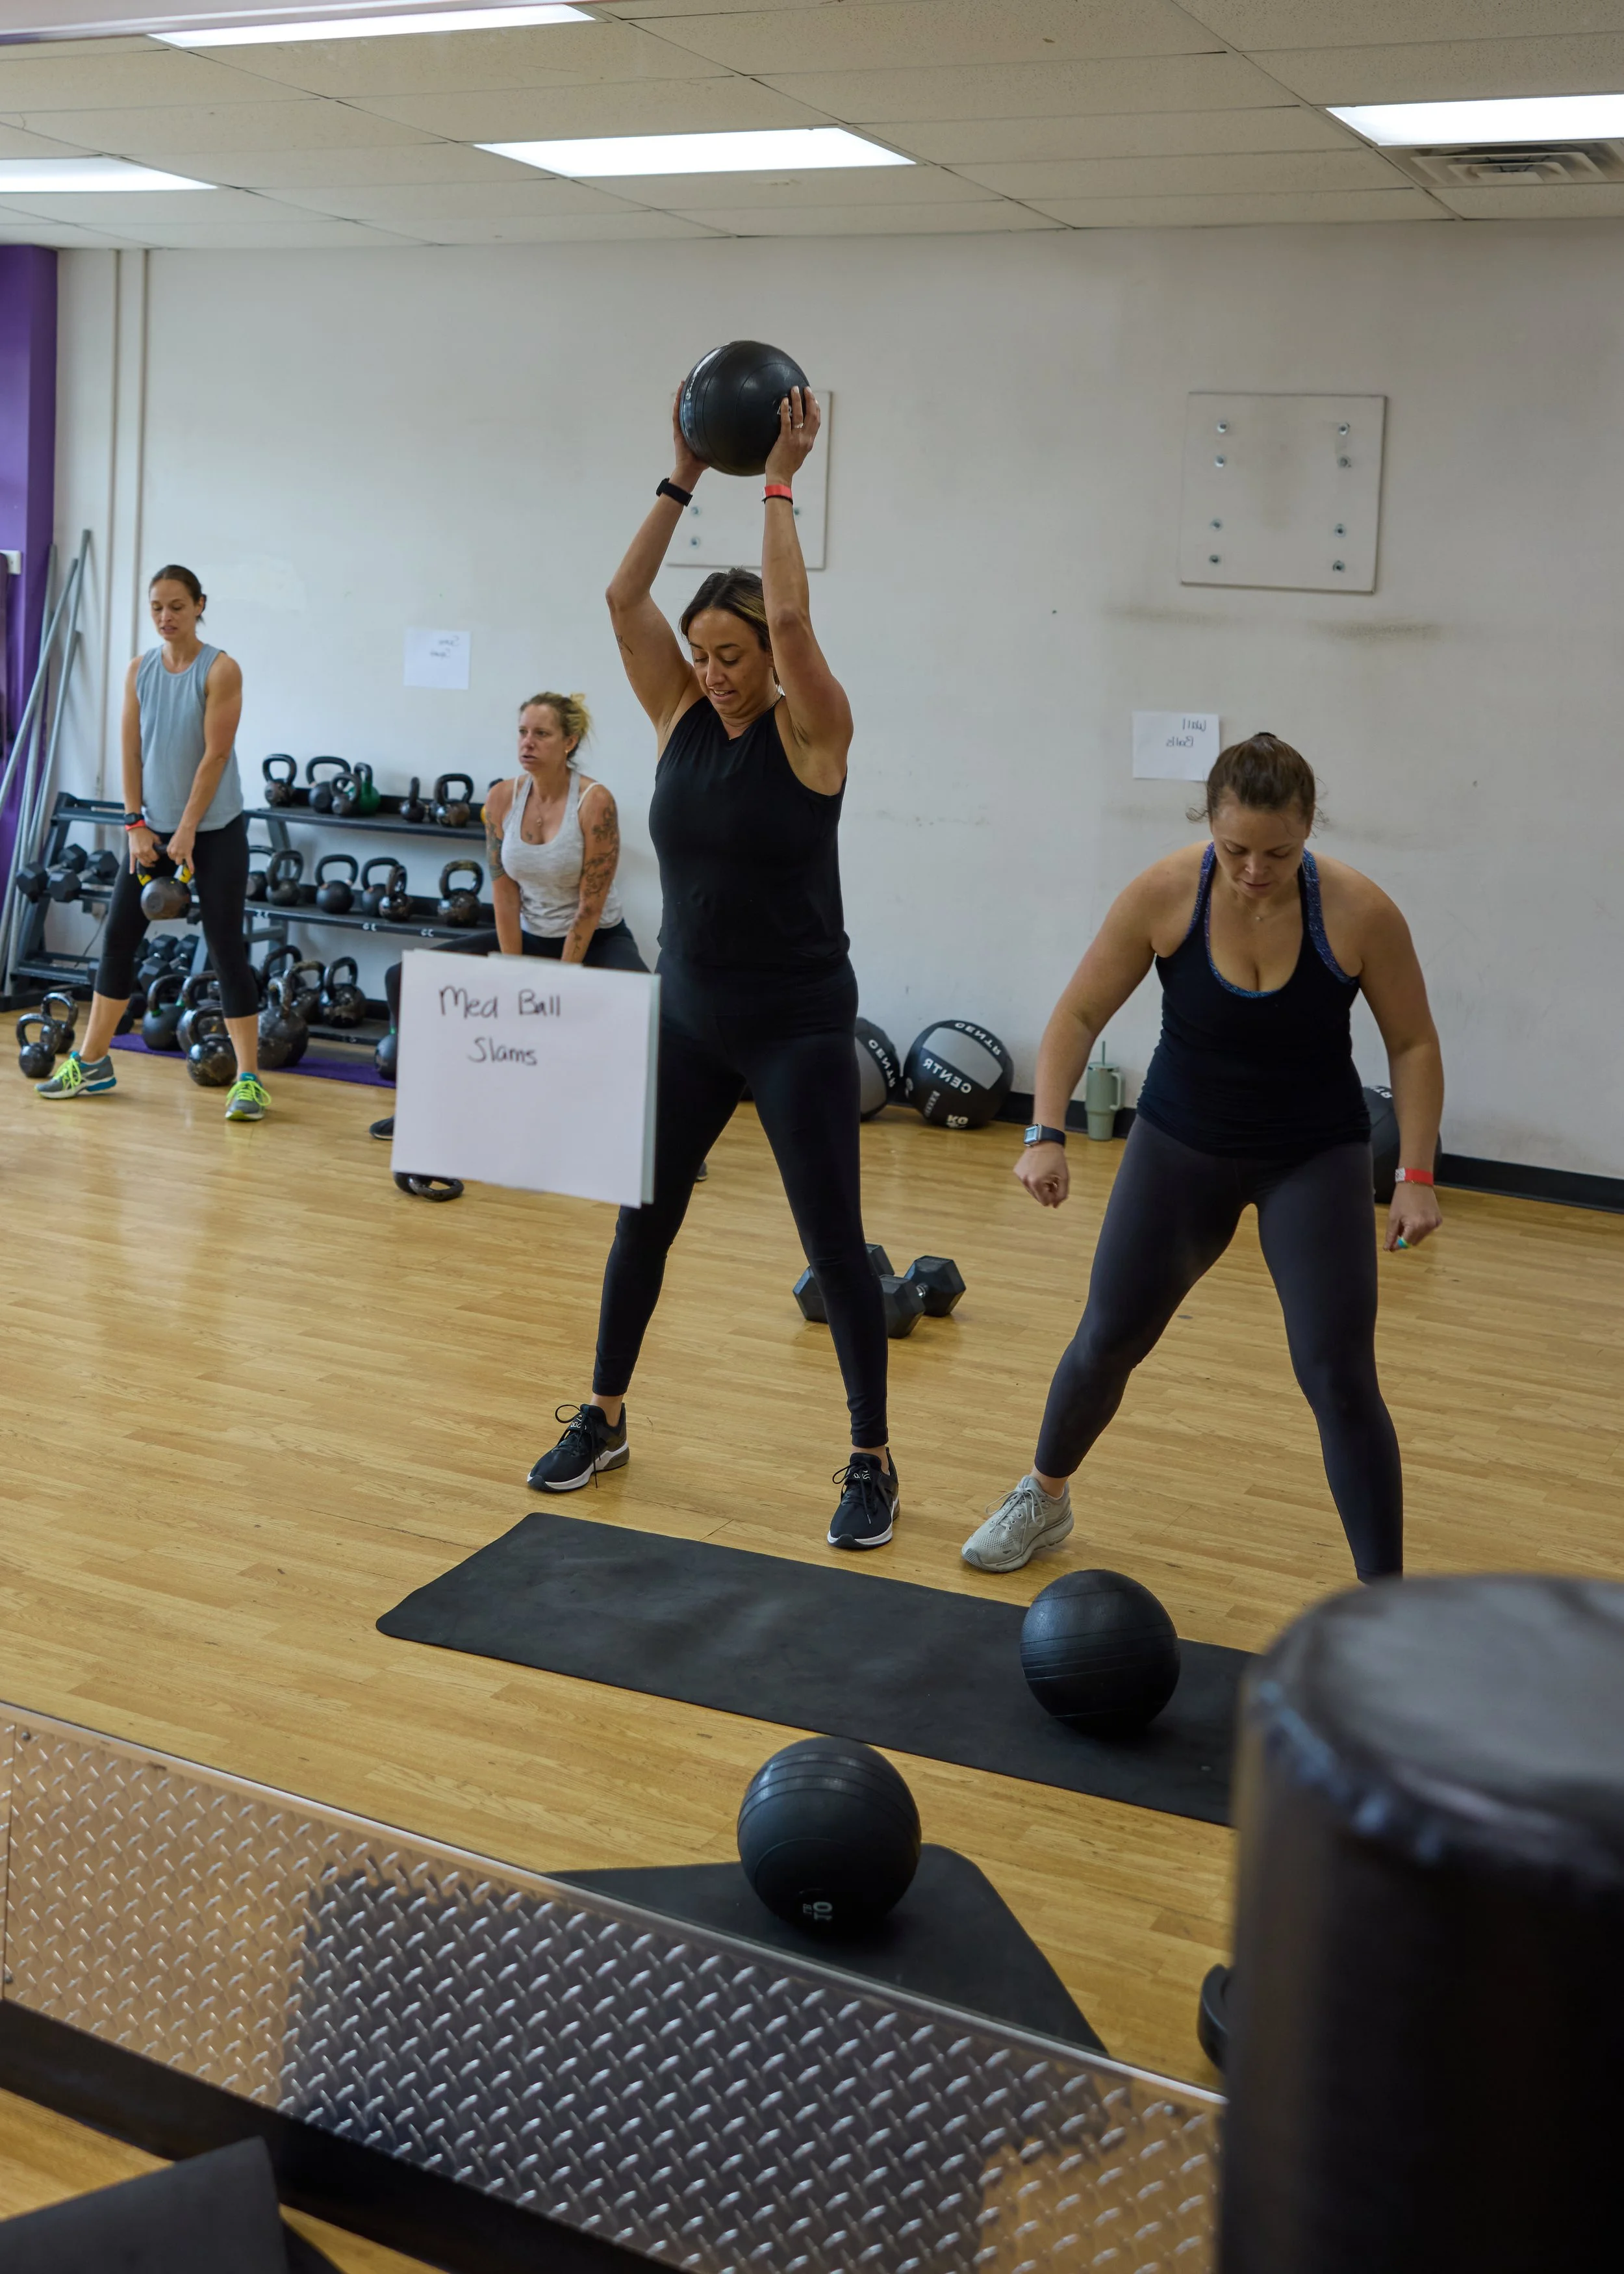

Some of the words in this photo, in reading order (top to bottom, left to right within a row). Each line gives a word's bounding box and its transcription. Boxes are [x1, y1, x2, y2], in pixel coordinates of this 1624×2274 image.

[438, 986, 498, 1019] Med
[518, 989, 561, 1017] Ball
[467, 1037, 538, 1066] Slams
